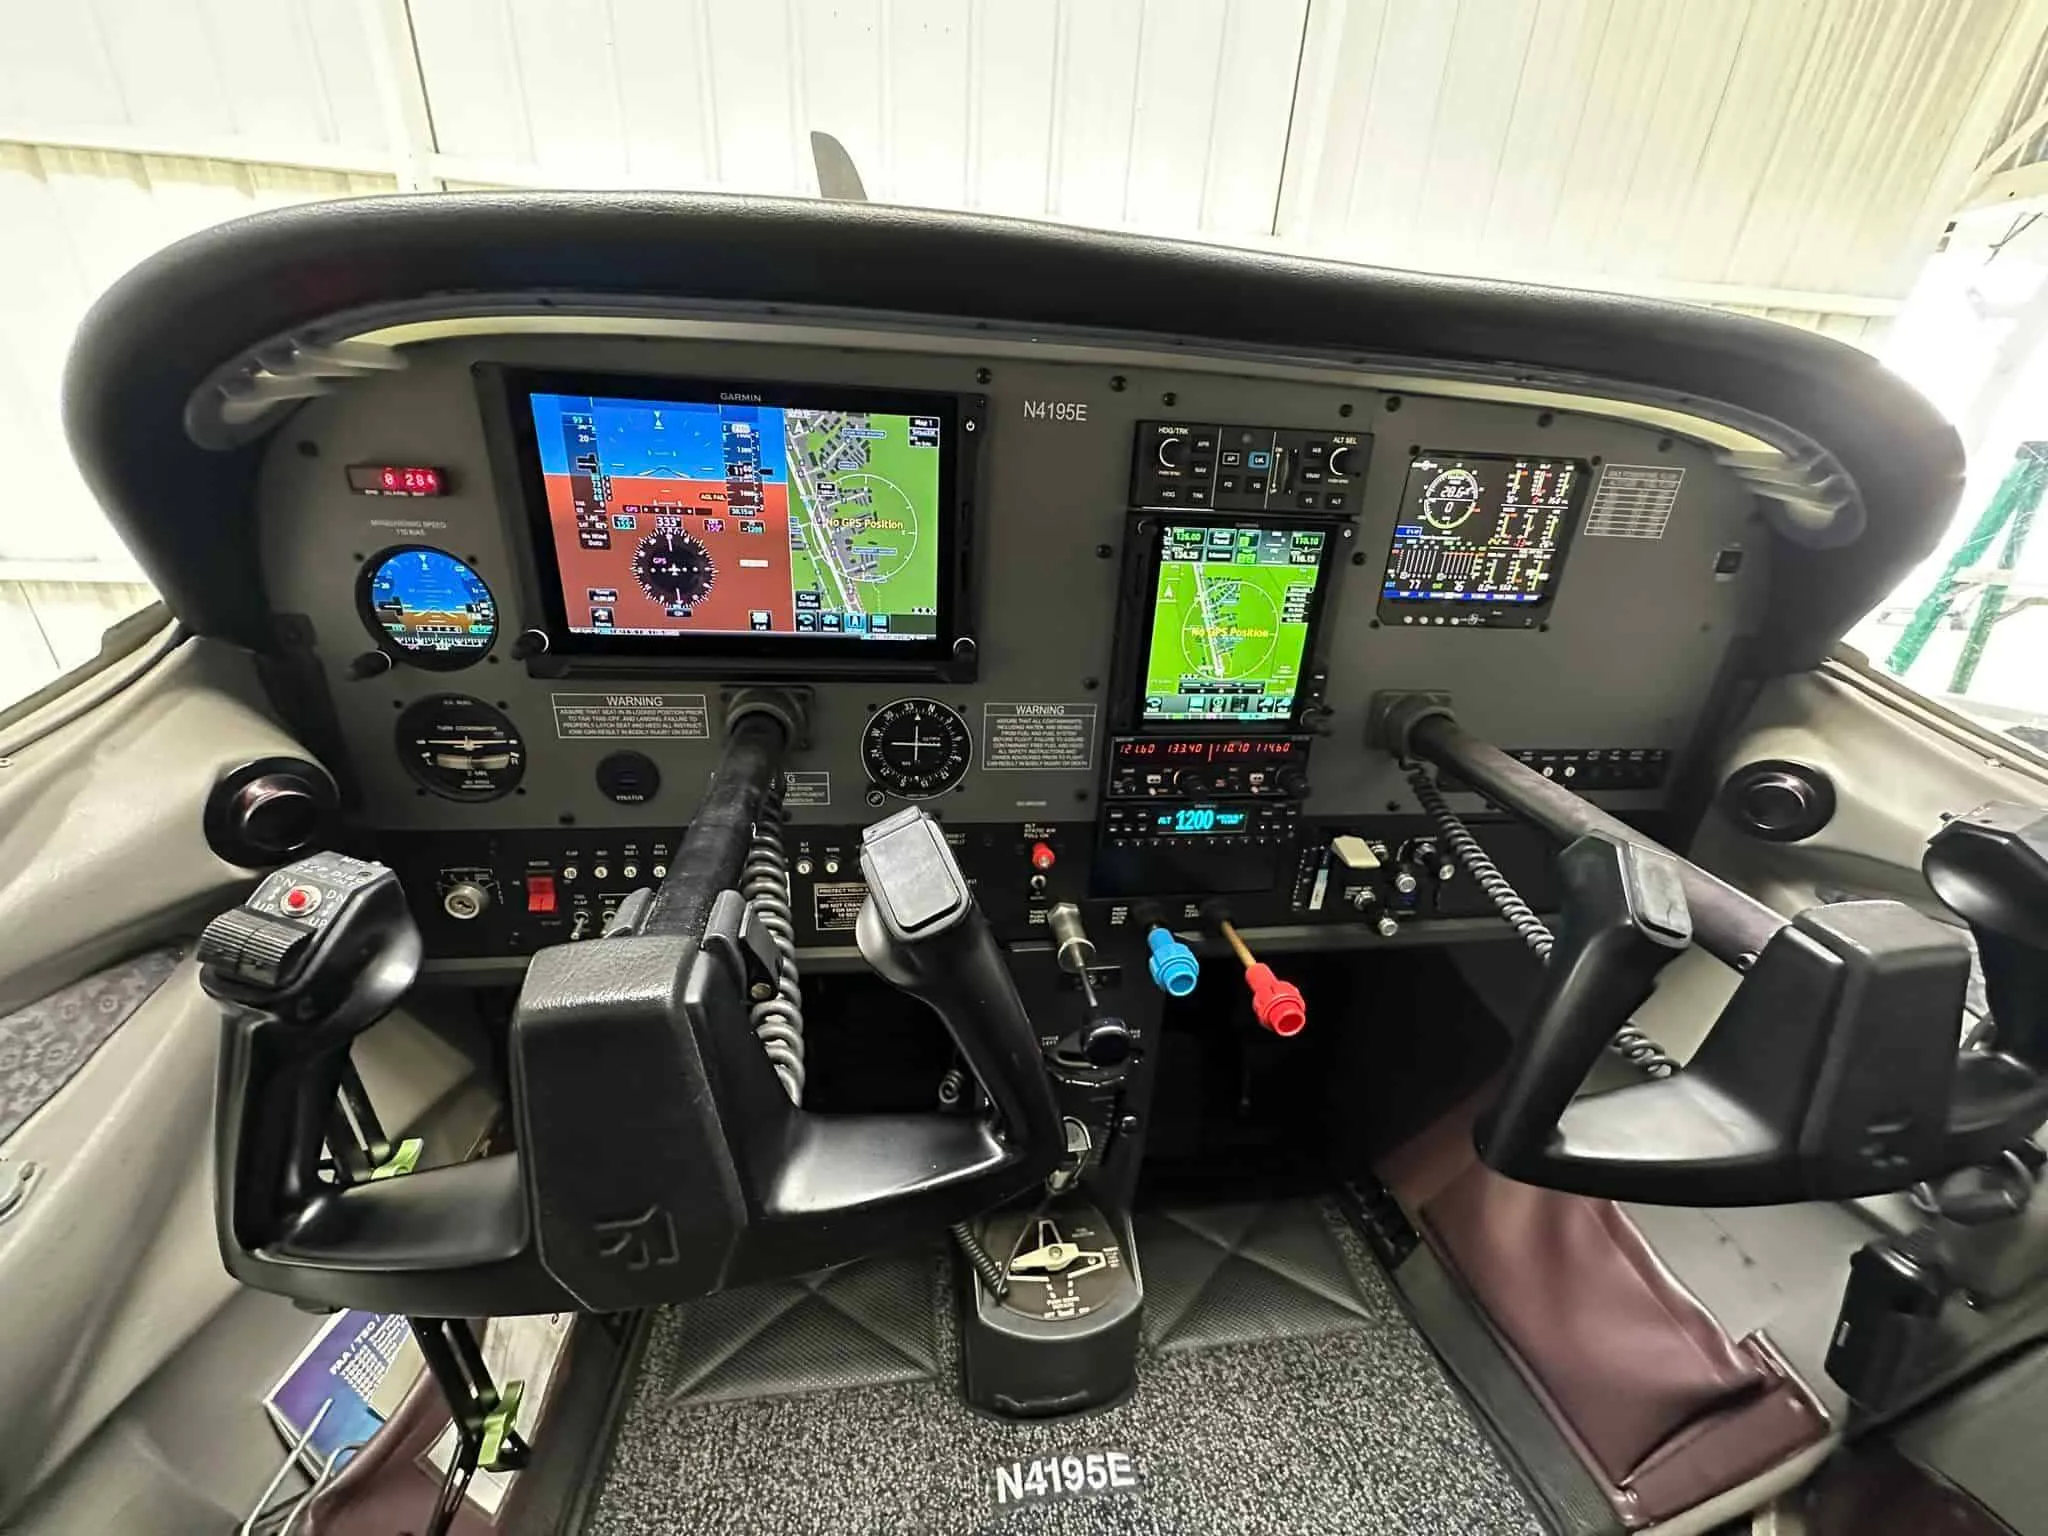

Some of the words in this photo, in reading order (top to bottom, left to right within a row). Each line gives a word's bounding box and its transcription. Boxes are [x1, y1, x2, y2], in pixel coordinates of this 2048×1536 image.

[720, 392, 762, 402] GARMIN
[1023, 400, 1088, 421] N4195E
[827, 518, 840, 527] No
[842, 519, 862, 528] GPS
[865, 519, 904, 530] Position
[1209, 628, 1229, 638] GPS
[1230, 628, 1269, 638] Position
[606, 696, 664, 706] WARNING
[904, 703, 914, 711] 33
[928, 704, 936, 712] N
[1016, 705, 1065, 715] WARNING
[1175, 810, 1214, 831] 1200
[326, 890, 347, 902] DN
[309, 916, 329, 929] UP
[995, 1451, 1136, 1504] N4195E
